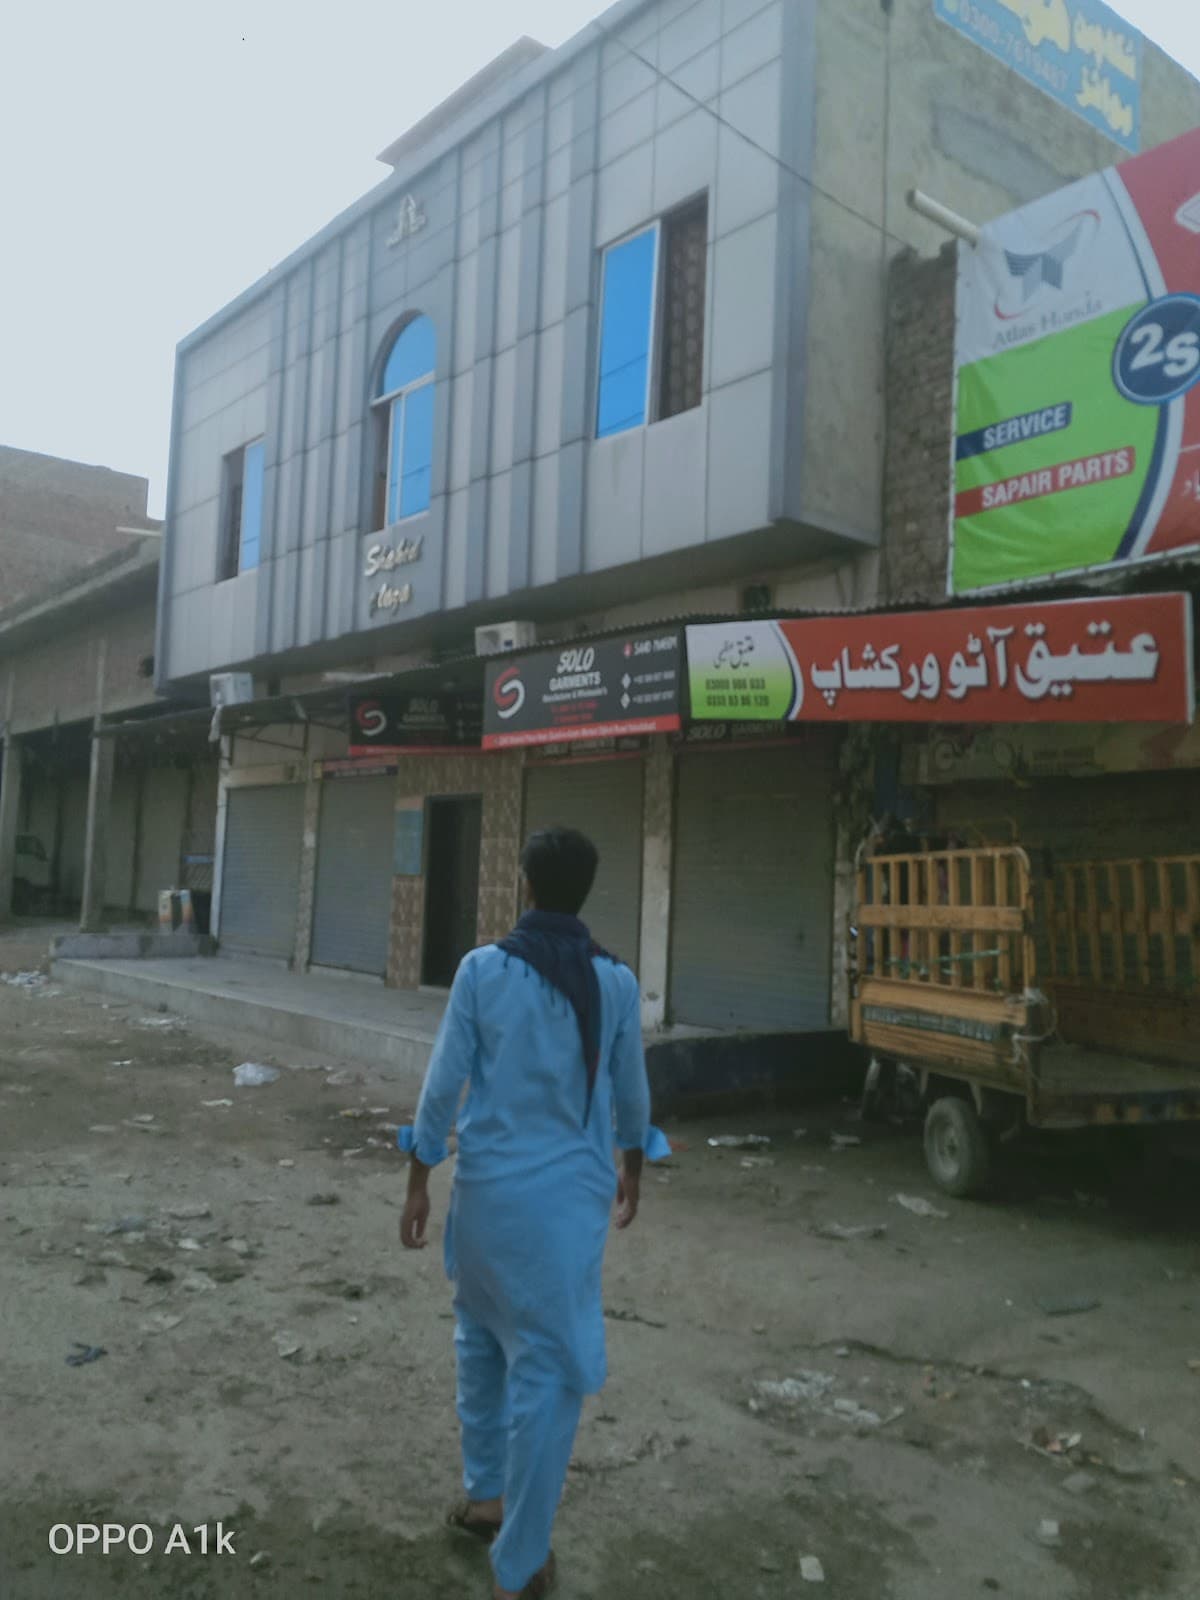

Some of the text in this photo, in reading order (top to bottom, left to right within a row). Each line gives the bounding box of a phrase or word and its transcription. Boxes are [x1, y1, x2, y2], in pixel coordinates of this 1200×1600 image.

[992, 320, 1036, 350] Atlas
[983, 404, 1067, 450] SERVICE
[982, 449, 1129, 508] SAPAIR PARTS
[557, 647, 595, 674] SOLO
[810, 620, 1160, 706] عتیق آٹو ورکشاپ
[549, 671, 601, 692] GARMENTS
